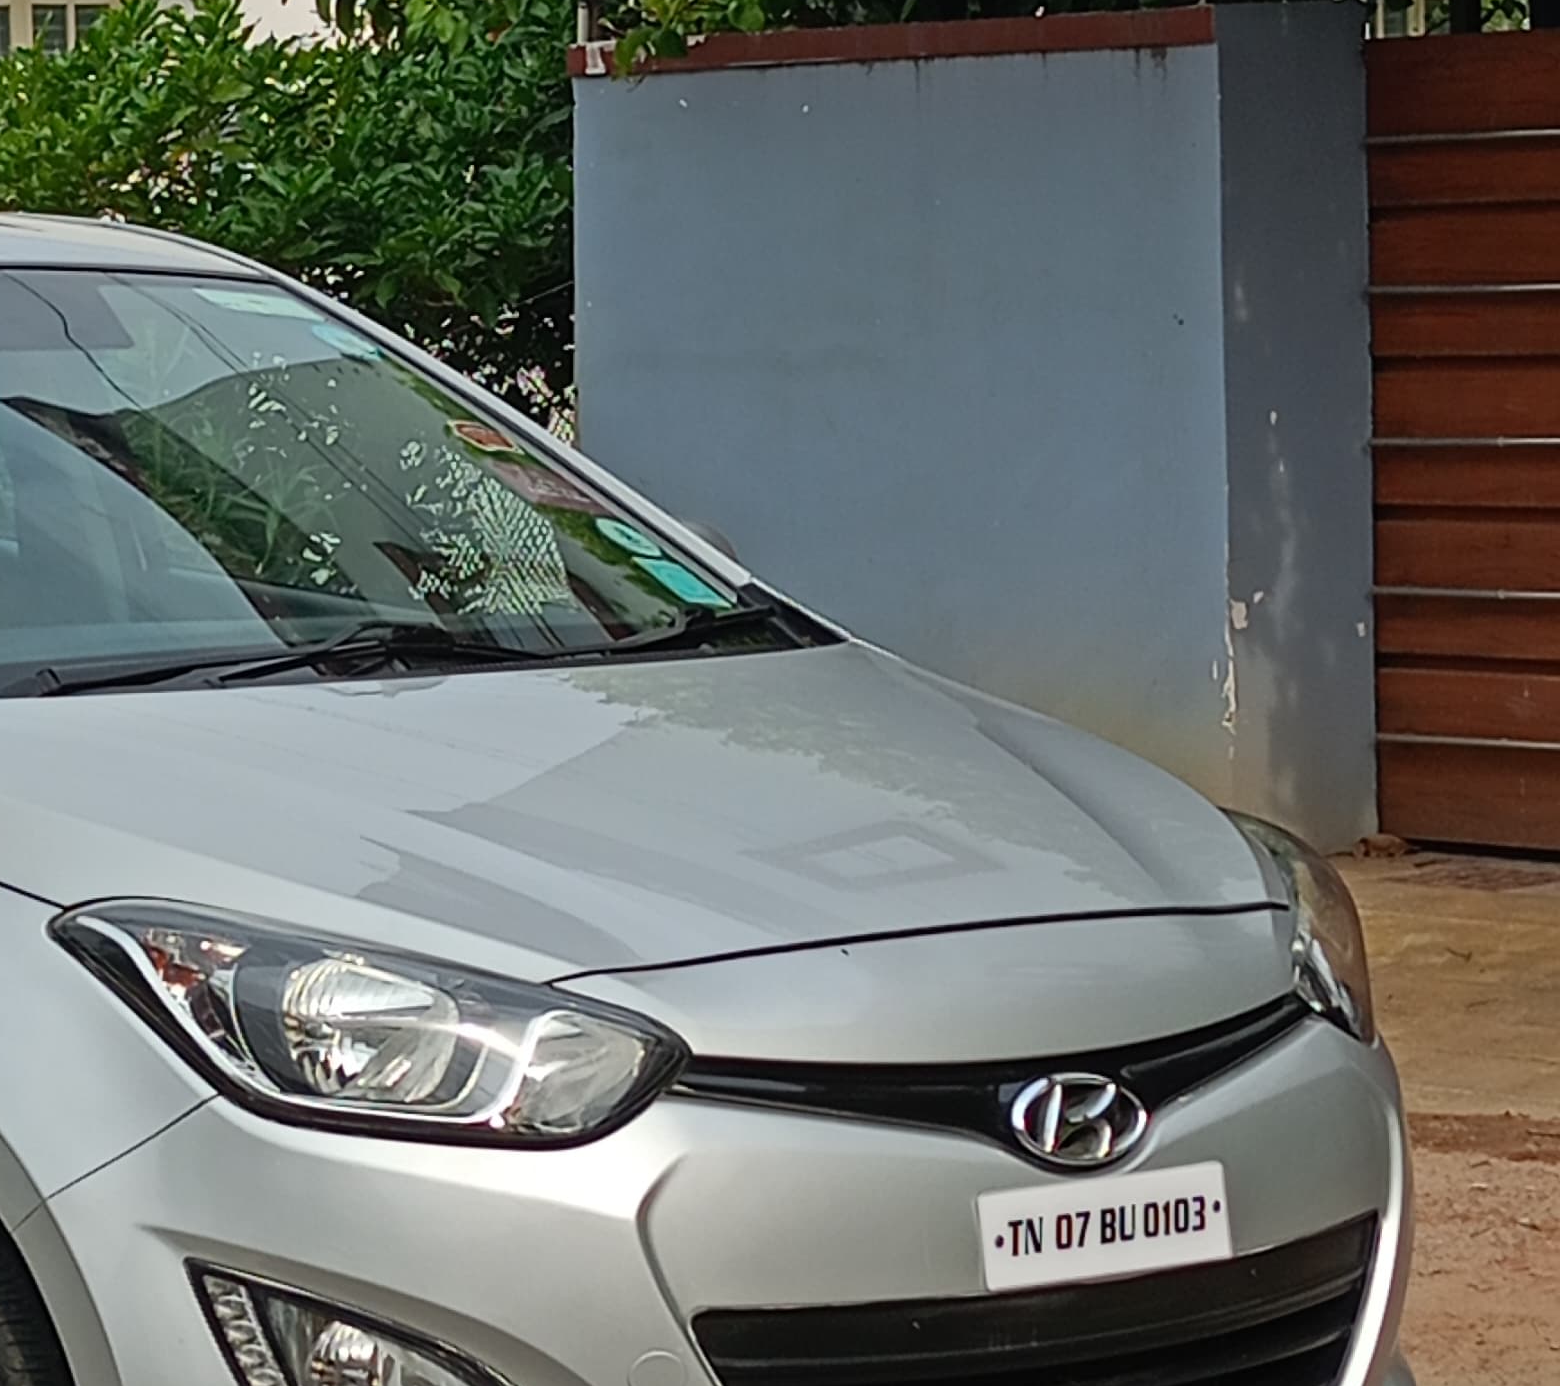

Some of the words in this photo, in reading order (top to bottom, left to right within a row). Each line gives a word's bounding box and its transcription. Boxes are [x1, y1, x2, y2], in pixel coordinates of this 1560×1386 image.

[1007, 1216, 1044, 1257] TN
[1055, 1210, 1091, 1250] 07
[1100, 1204, 1136, 1245] BU
[1143, 1195, 1206, 1238] 0103
